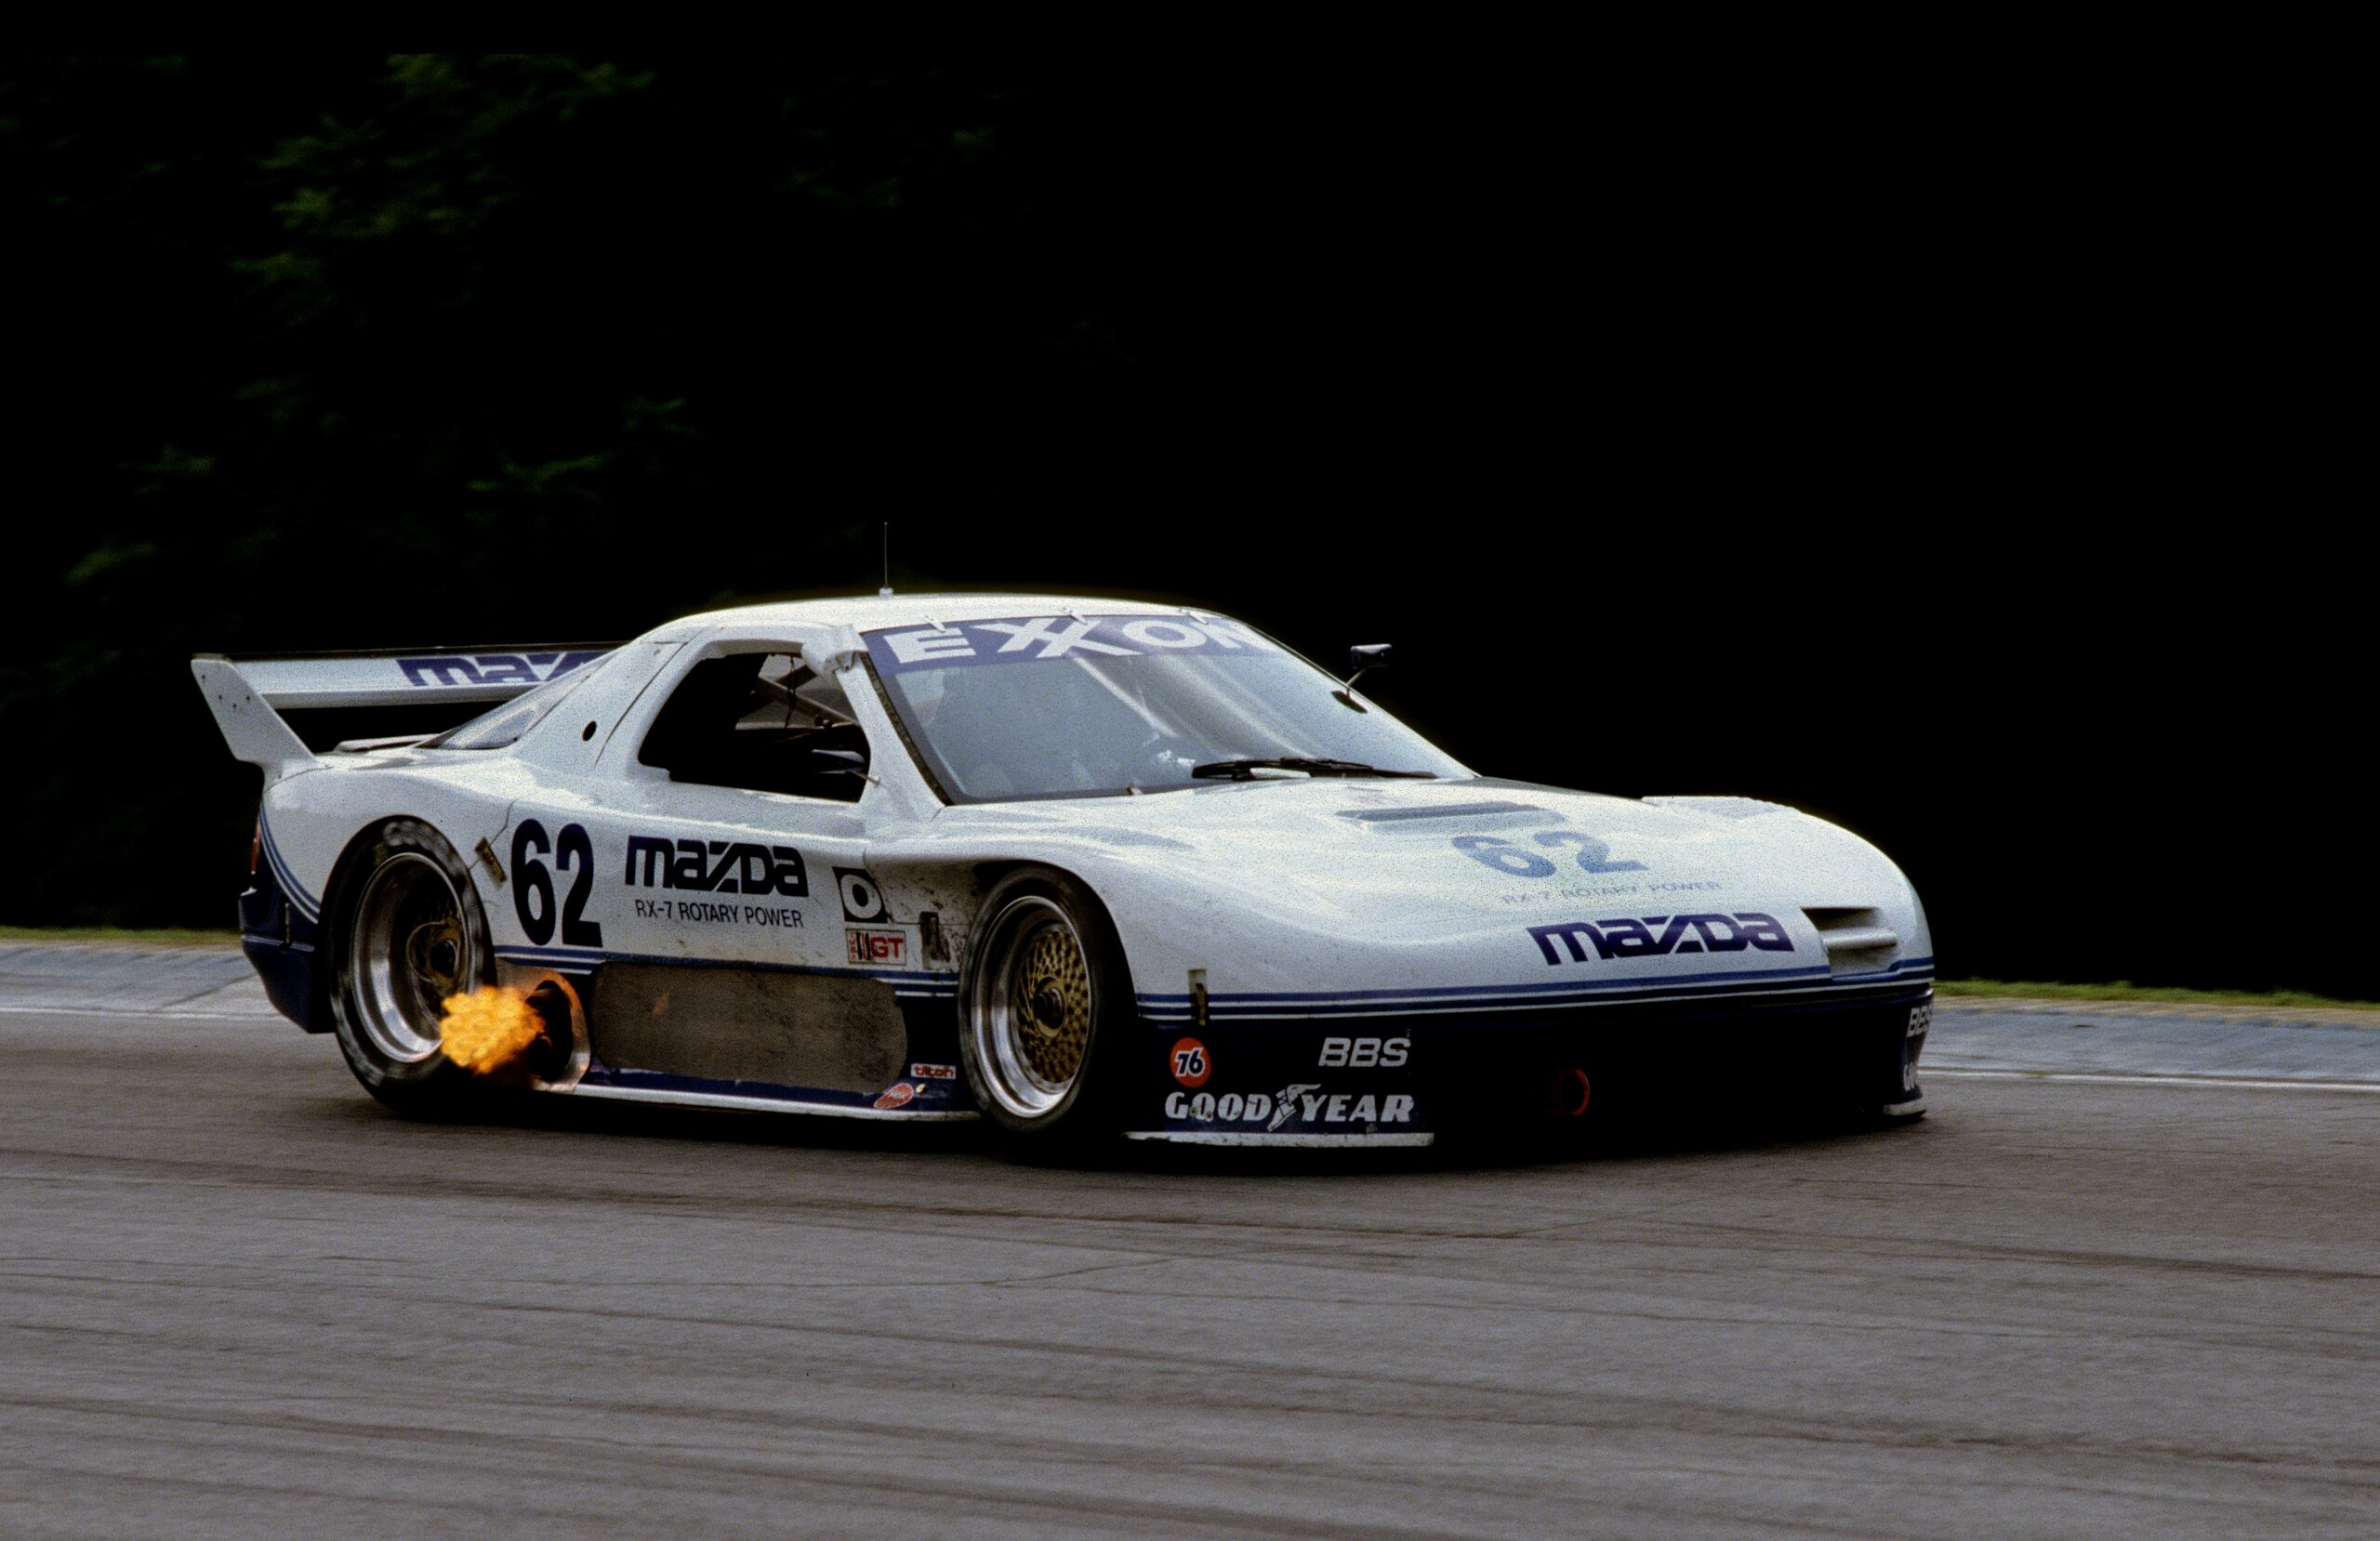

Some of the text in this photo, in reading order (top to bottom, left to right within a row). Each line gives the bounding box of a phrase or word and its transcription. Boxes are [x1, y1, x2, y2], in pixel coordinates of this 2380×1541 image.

[882, 616, 1279, 664] EXXON
[625, 835, 809, 897] mazda
[1451, 831, 1648, 878] 62
[510, 819, 603, 946] 62
[1561, 883, 1639, 900] ROTARY
[1647, 880, 1723, 892] POWER
[635, 899, 804, 929] RX-7 ROTARY POWER
[870, 936, 905, 958] GT
[1526, 913, 1795, 967] mazda
[1174, 1047, 1206, 1078] 76
[1318, 1036, 1411, 1068] BBS
